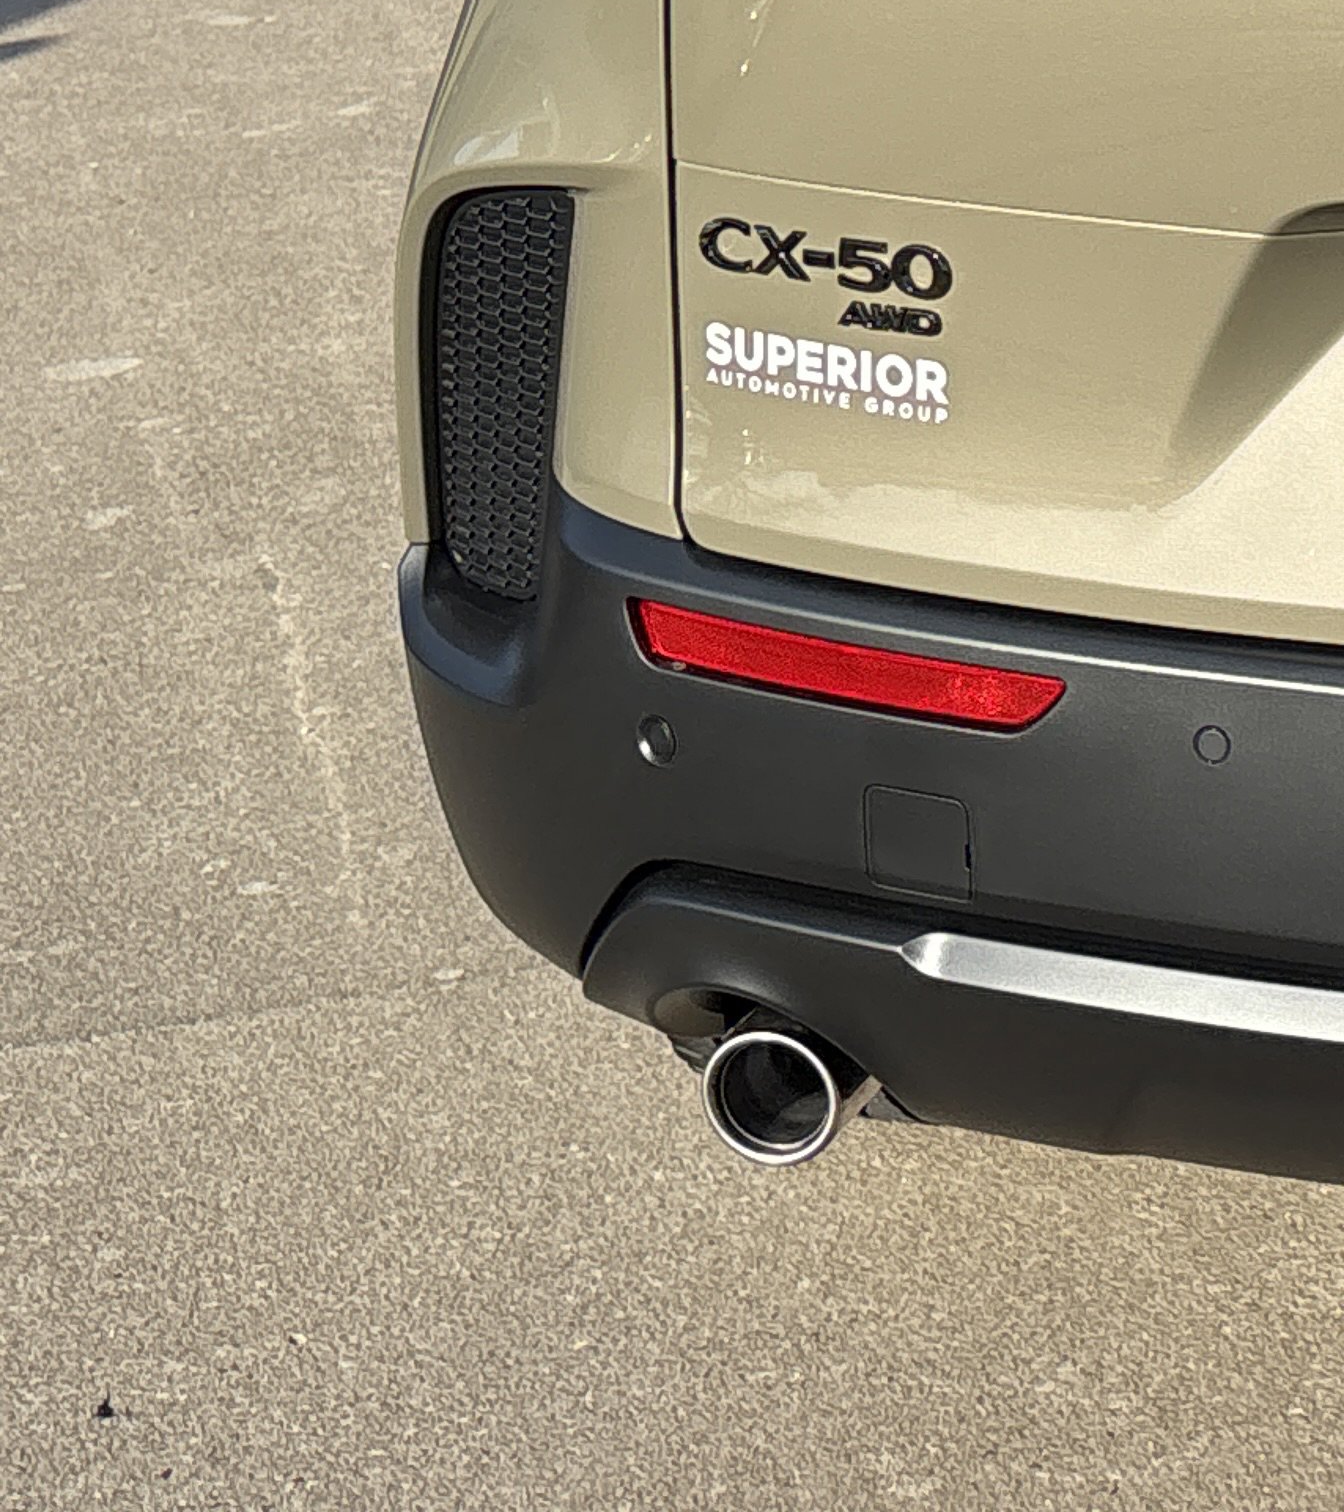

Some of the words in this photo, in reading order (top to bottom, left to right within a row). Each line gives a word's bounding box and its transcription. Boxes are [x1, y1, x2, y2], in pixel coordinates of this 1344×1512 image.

[698, 216, 953, 301] CX-50
[837, 300, 943, 337] AWD
[705, 321, 949, 404] SUPERIOR
[705, 368, 851, 410] AUTOMOTIVE
[864, 396, 950, 424] GROUP
